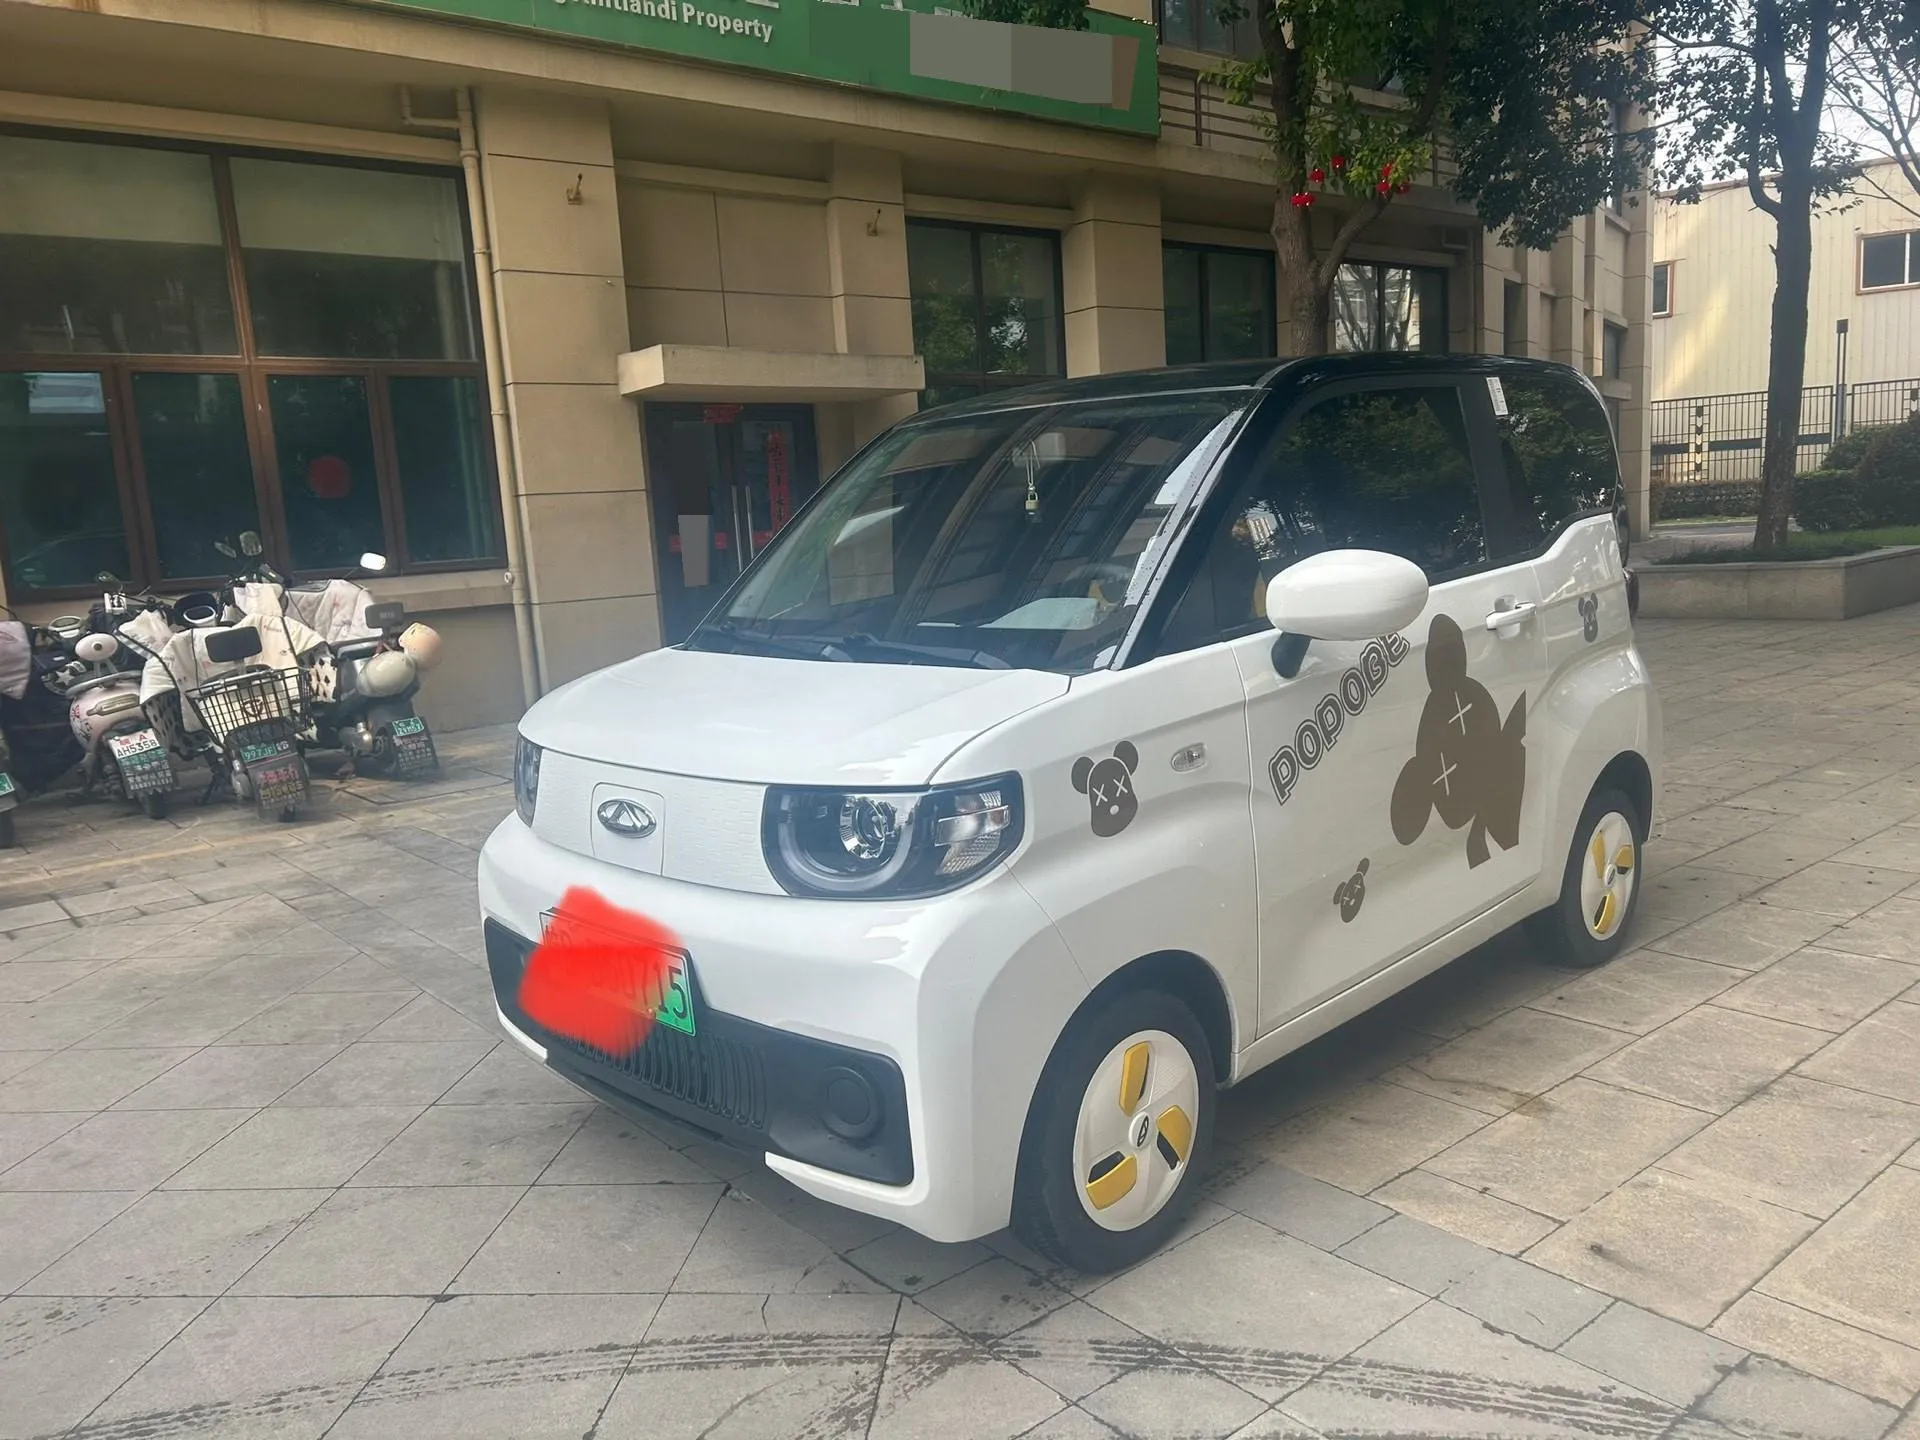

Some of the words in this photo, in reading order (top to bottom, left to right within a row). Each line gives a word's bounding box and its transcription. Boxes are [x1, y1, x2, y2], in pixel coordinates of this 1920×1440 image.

[682, 3, 773, 42] Property
[1268, 632, 1411, 806] POPOBE
[116, 739, 158, 757] AH5358
